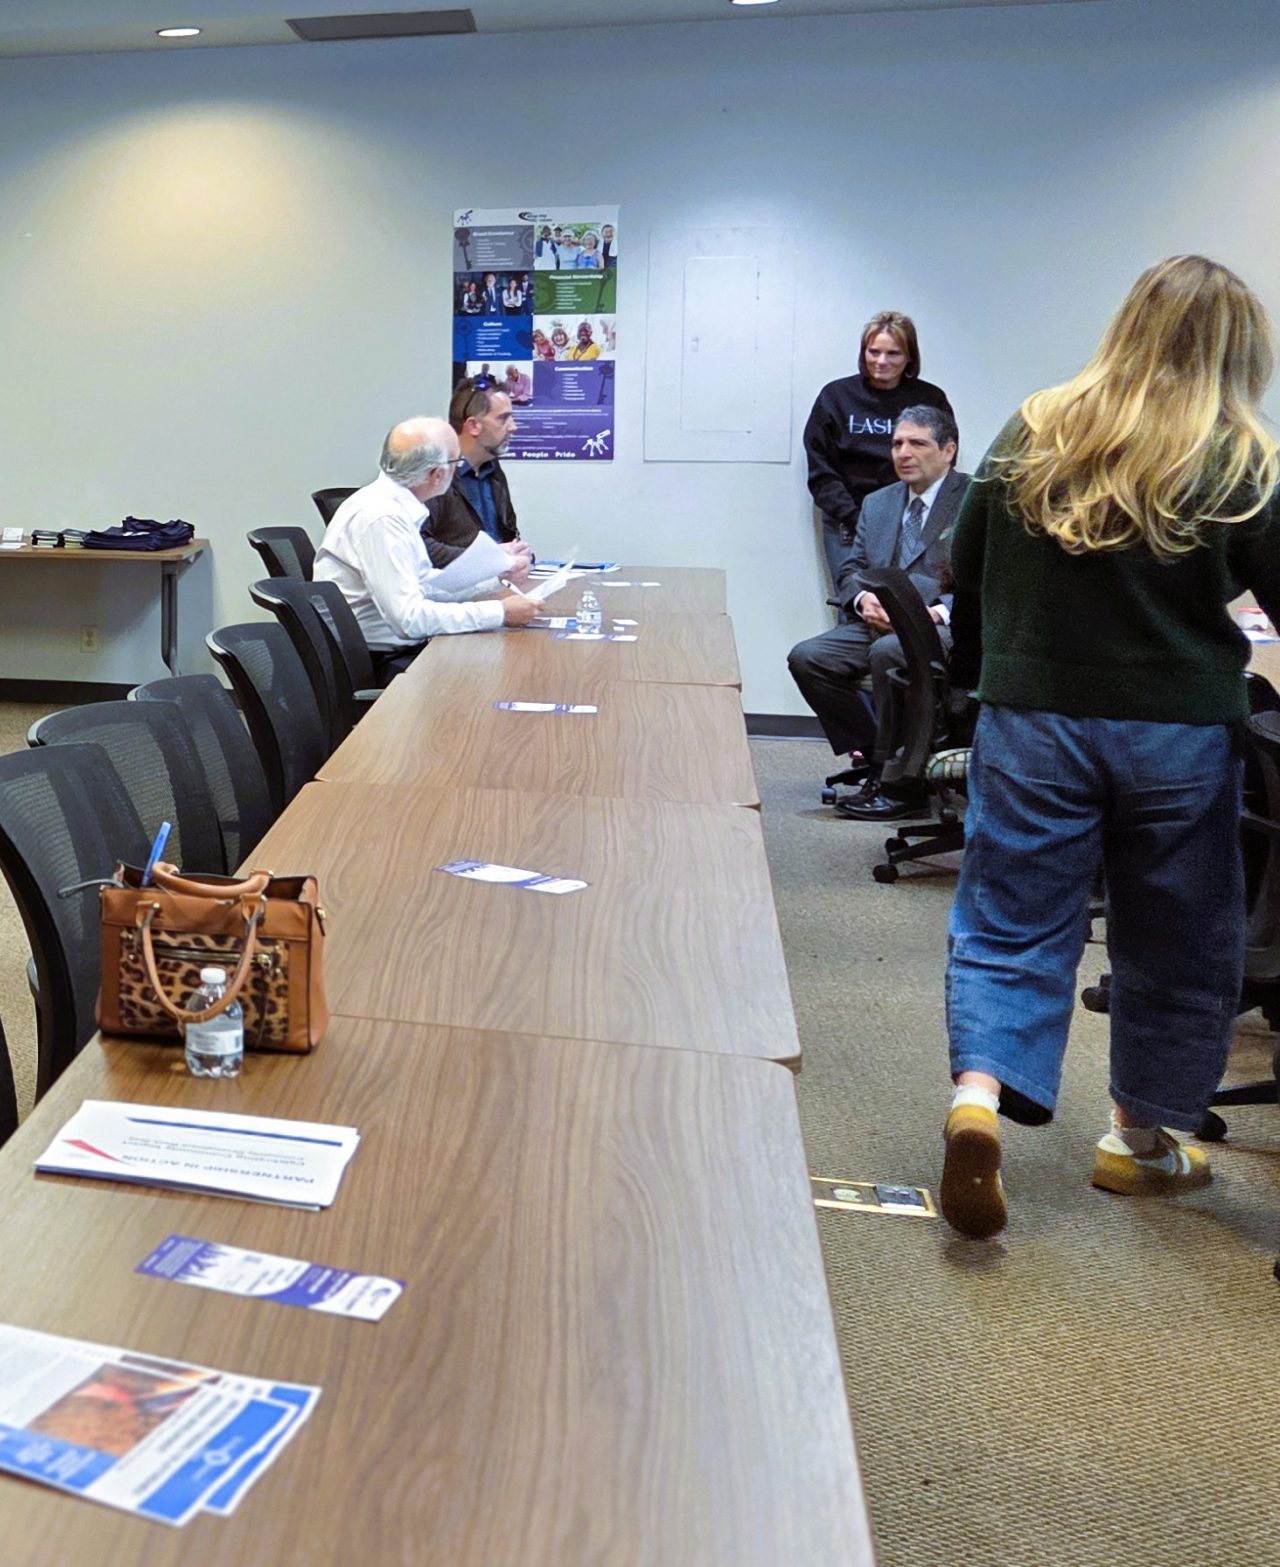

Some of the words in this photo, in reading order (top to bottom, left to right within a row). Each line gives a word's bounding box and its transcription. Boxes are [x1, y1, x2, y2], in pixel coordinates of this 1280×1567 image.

[522, 451, 549, 459] People
[122, 1154, 180, 1166] ACTION
[204, 1166, 315, 1183] PARTNERSHIP
